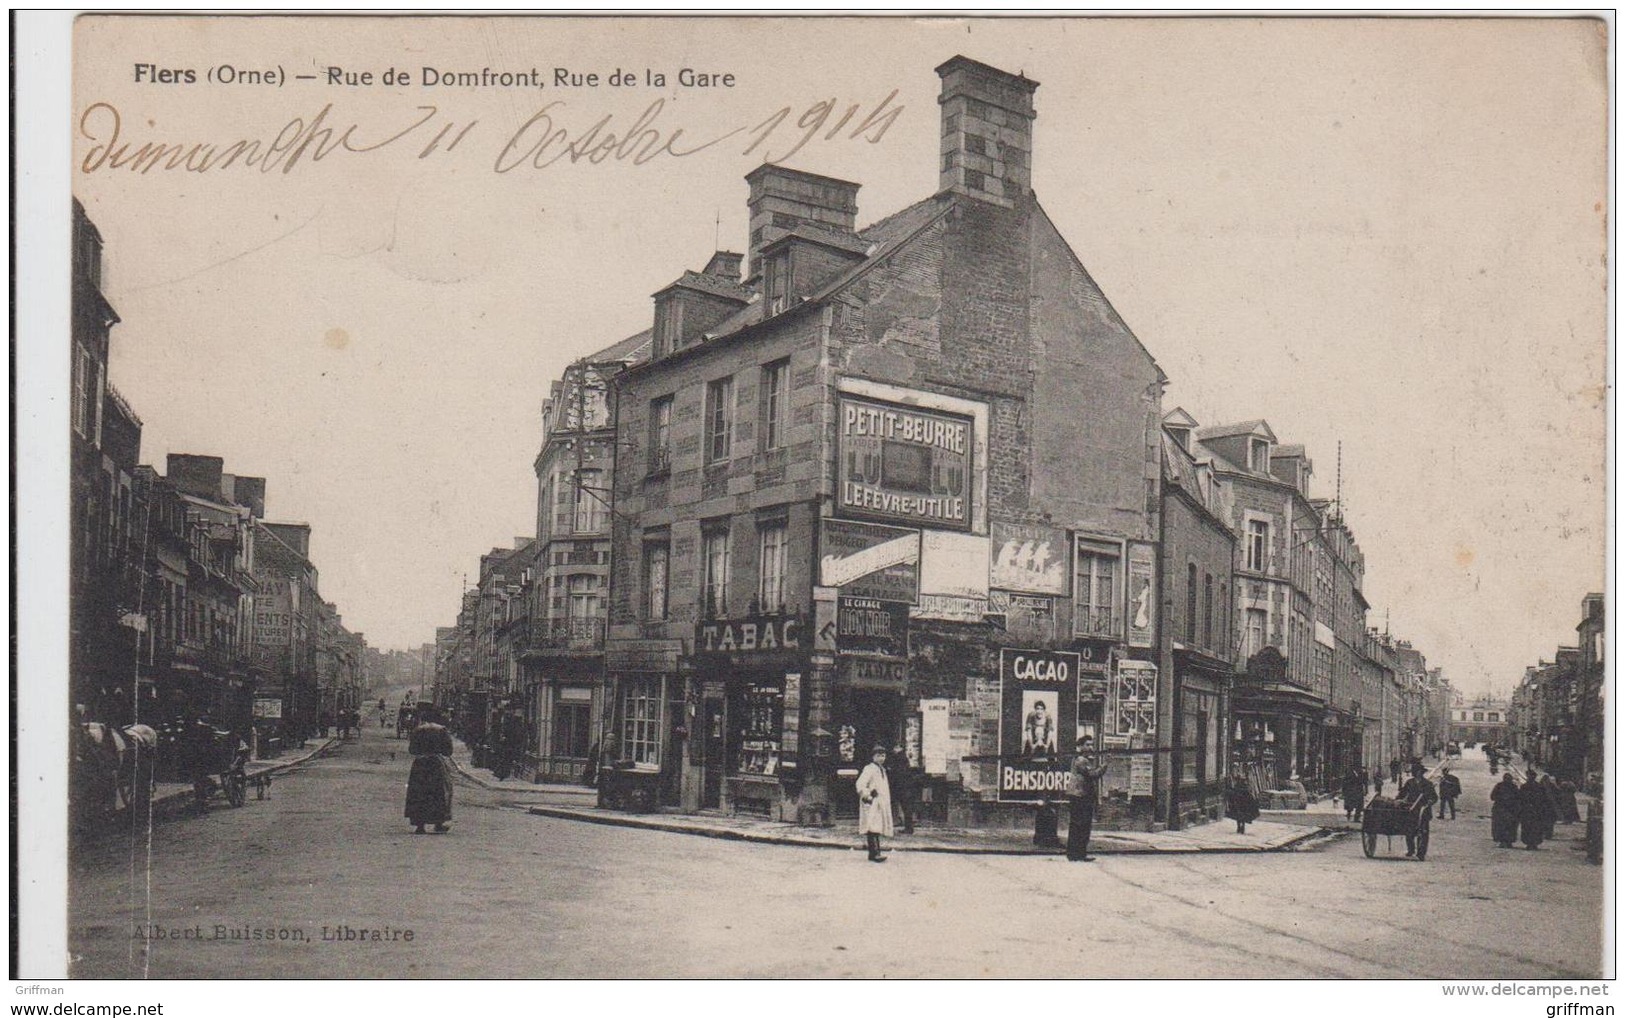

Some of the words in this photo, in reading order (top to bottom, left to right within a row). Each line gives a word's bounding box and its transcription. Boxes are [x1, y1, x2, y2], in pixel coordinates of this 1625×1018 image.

[742, 88, 906, 164] 1914
[844, 404, 965, 456] PETIT-BEURRE
[844, 598, 853, 607] LE
[702, 619, 800, 651] TABAC
[1014, 656, 1068, 682] CACAO
